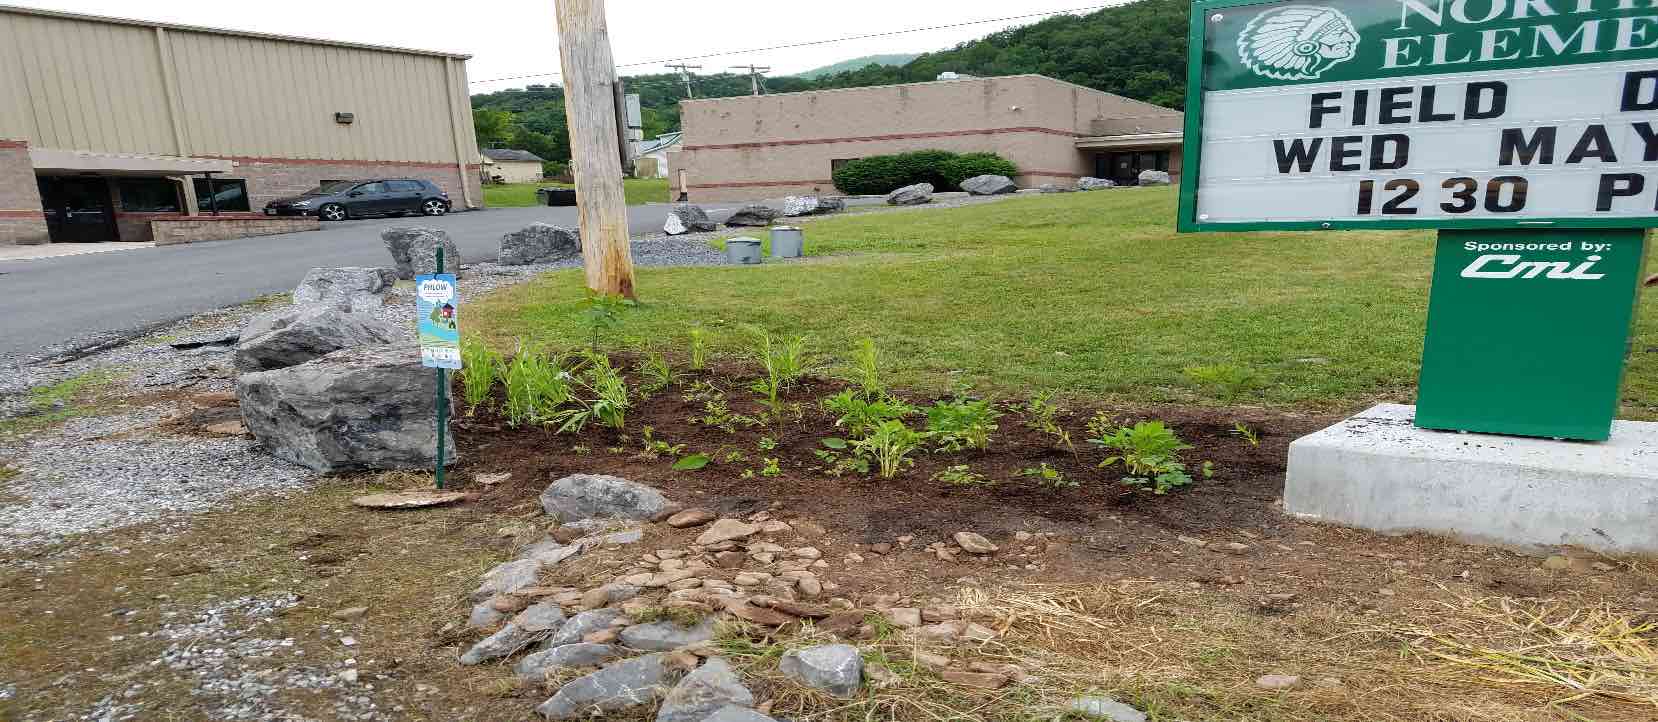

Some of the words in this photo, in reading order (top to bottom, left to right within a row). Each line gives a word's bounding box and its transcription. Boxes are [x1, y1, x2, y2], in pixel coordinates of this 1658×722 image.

[1378, 15, 1658, 69] ELEME
[1308, 80, 1508, 128] FIELD
[1273, 133, 1410, 173] WED
[1357, 178, 1420, 215] 12
[1439, 175, 1529, 213] 30
[1596, 172, 1658, 212] P
[1460, 254, 1606, 280] Cmi
[1463, 241, 1572, 252] Sponsored
[1581, 241, 1612, 252] by:
